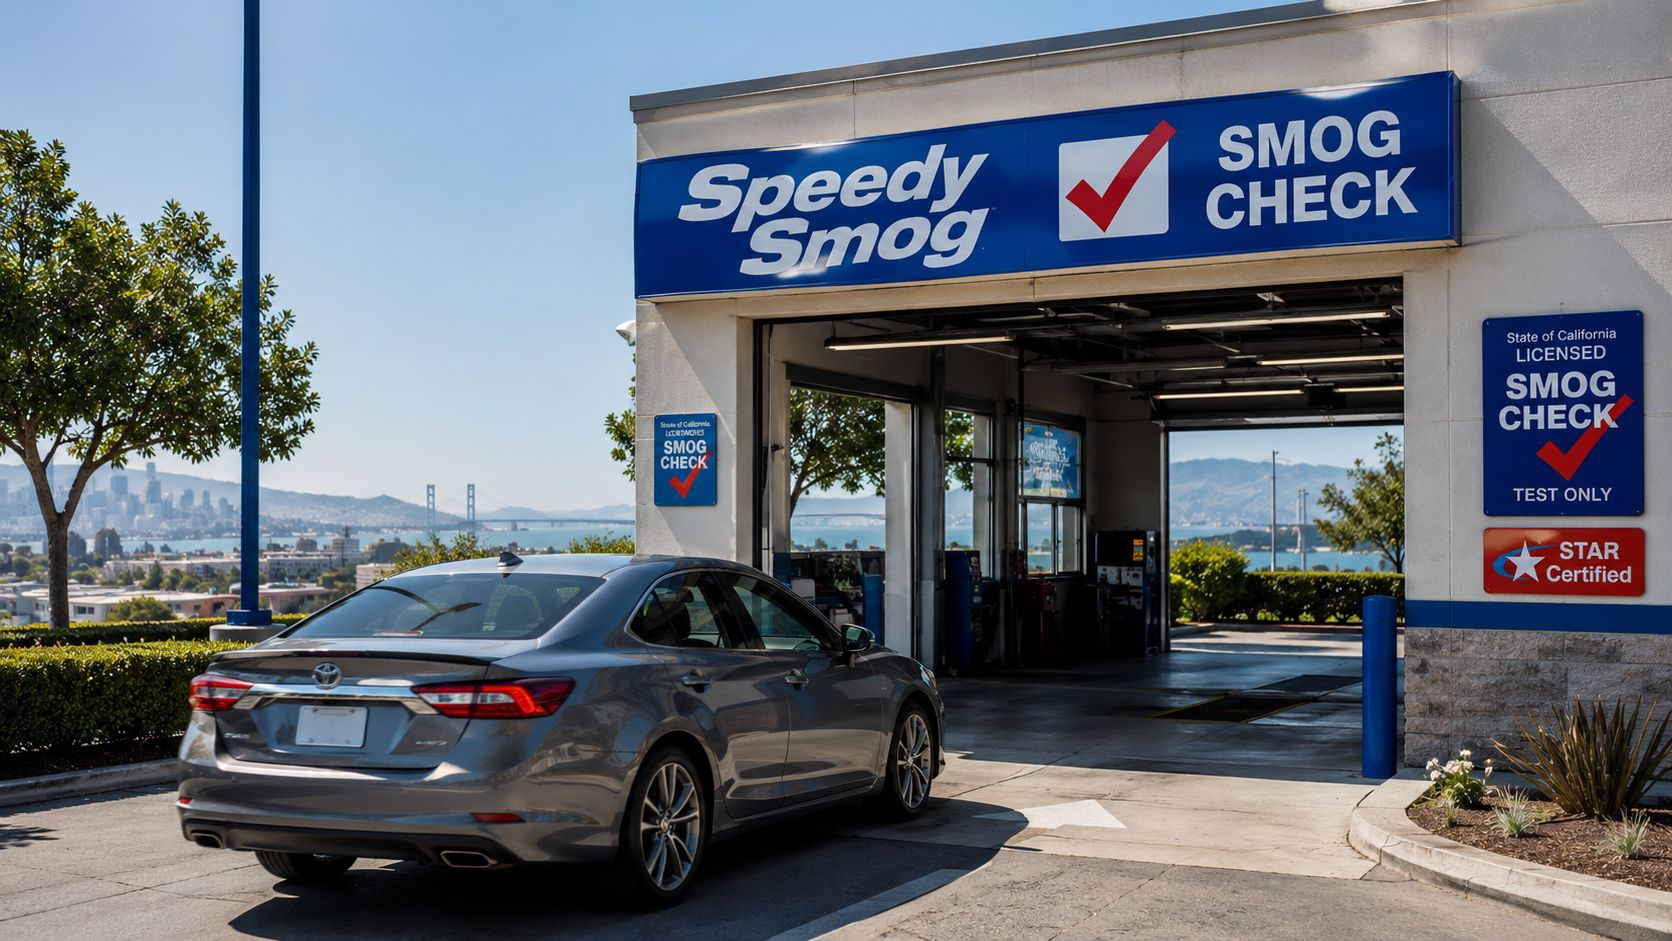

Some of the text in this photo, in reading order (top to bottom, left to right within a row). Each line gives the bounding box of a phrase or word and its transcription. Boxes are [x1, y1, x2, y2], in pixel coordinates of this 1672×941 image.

[1218, 110, 1401, 171] SMOG
[677, 143, 989, 233] Speedy
[1206, 167, 1418, 229] CHECK
[739, 208, 989, 276] Smog
[1507, 328, 1617, 344] State of California
[1516, 345, 1606, 363] LICENSED
[1505, 370, 1616, 400] SMOG
[1499, 403, 1619, 431] CHECK
[664, 440, 707, 455] SMOG
[660, 455, 708, 469] CHECK
[1513, 487, 1612, 502] TEST ONLY
[1559, 541, 1619, 560] STAR
[1546, 565, 1632, 583] Certified
